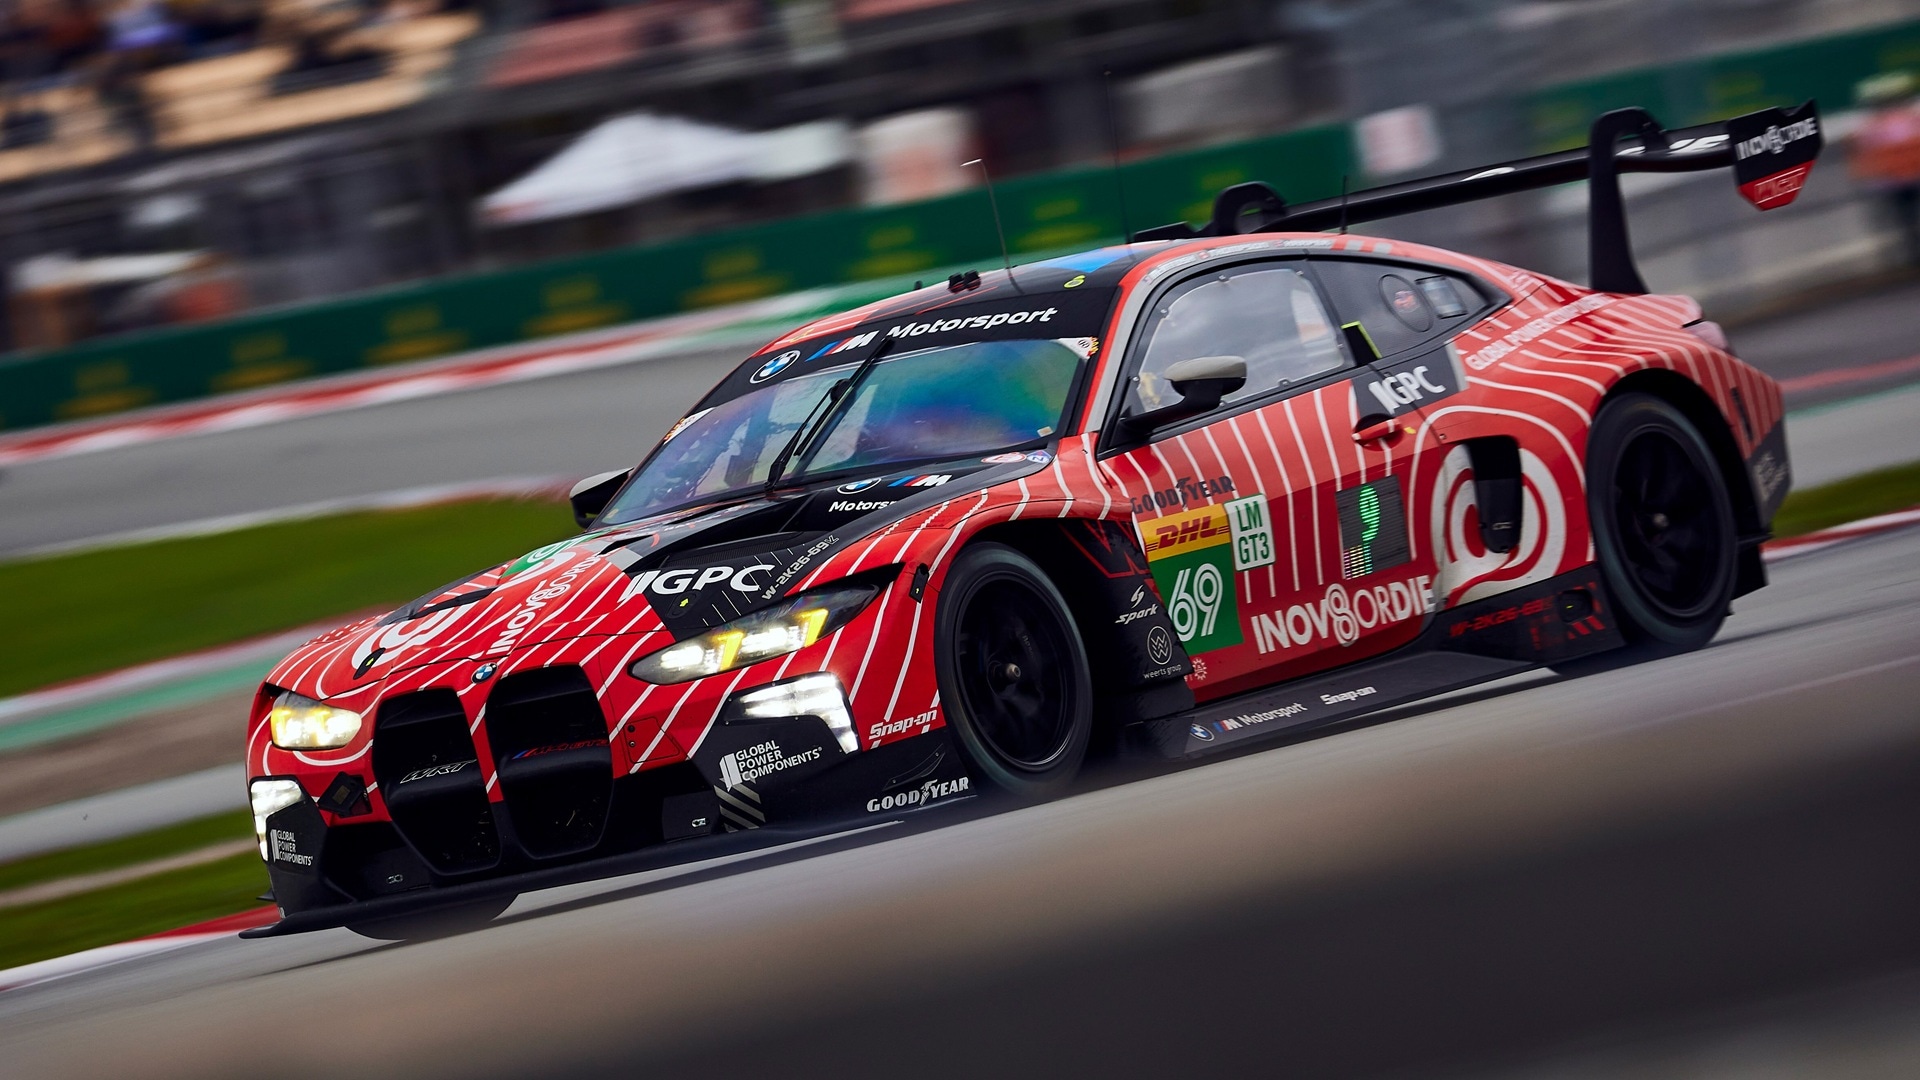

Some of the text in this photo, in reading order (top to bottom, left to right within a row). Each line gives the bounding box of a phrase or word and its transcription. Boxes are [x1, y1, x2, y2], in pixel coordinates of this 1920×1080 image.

[886, 307, 1059, 340] Motorsport
[1130, 475, 1237, 515] GOODYEAR
[1156, 515, 1219, 549] DHL
[1235, 500, 1264, 532] LM
[1237, 531, 1271, 565] GT3
[1114, 602, 1159, 625] spark
[1167, 562, 1224, 642] 69
[1250, 574, 1437, 655] INOV8ORDIE
[1142, 667, 1167, 680] weerts
[1167, 663, 1183, 678] group
[1320, 686, 1378, 705] Snap-on
[868, 708, 938, 740] Snap-on
[1241, 703, 1309, 727] Motorsport
[735, 739, 781, 761] GLOBAL
[738, 749, 784, 772] POWER
[741, 748, 822, 782] COMPONENTS
[866, 777, 970, 812] GOODYEAR
[277, 829, 296, 843] GLOBAL
[278, 841, 297, 853] POWER
[279, 851, 313, 867] COMPONENTS
